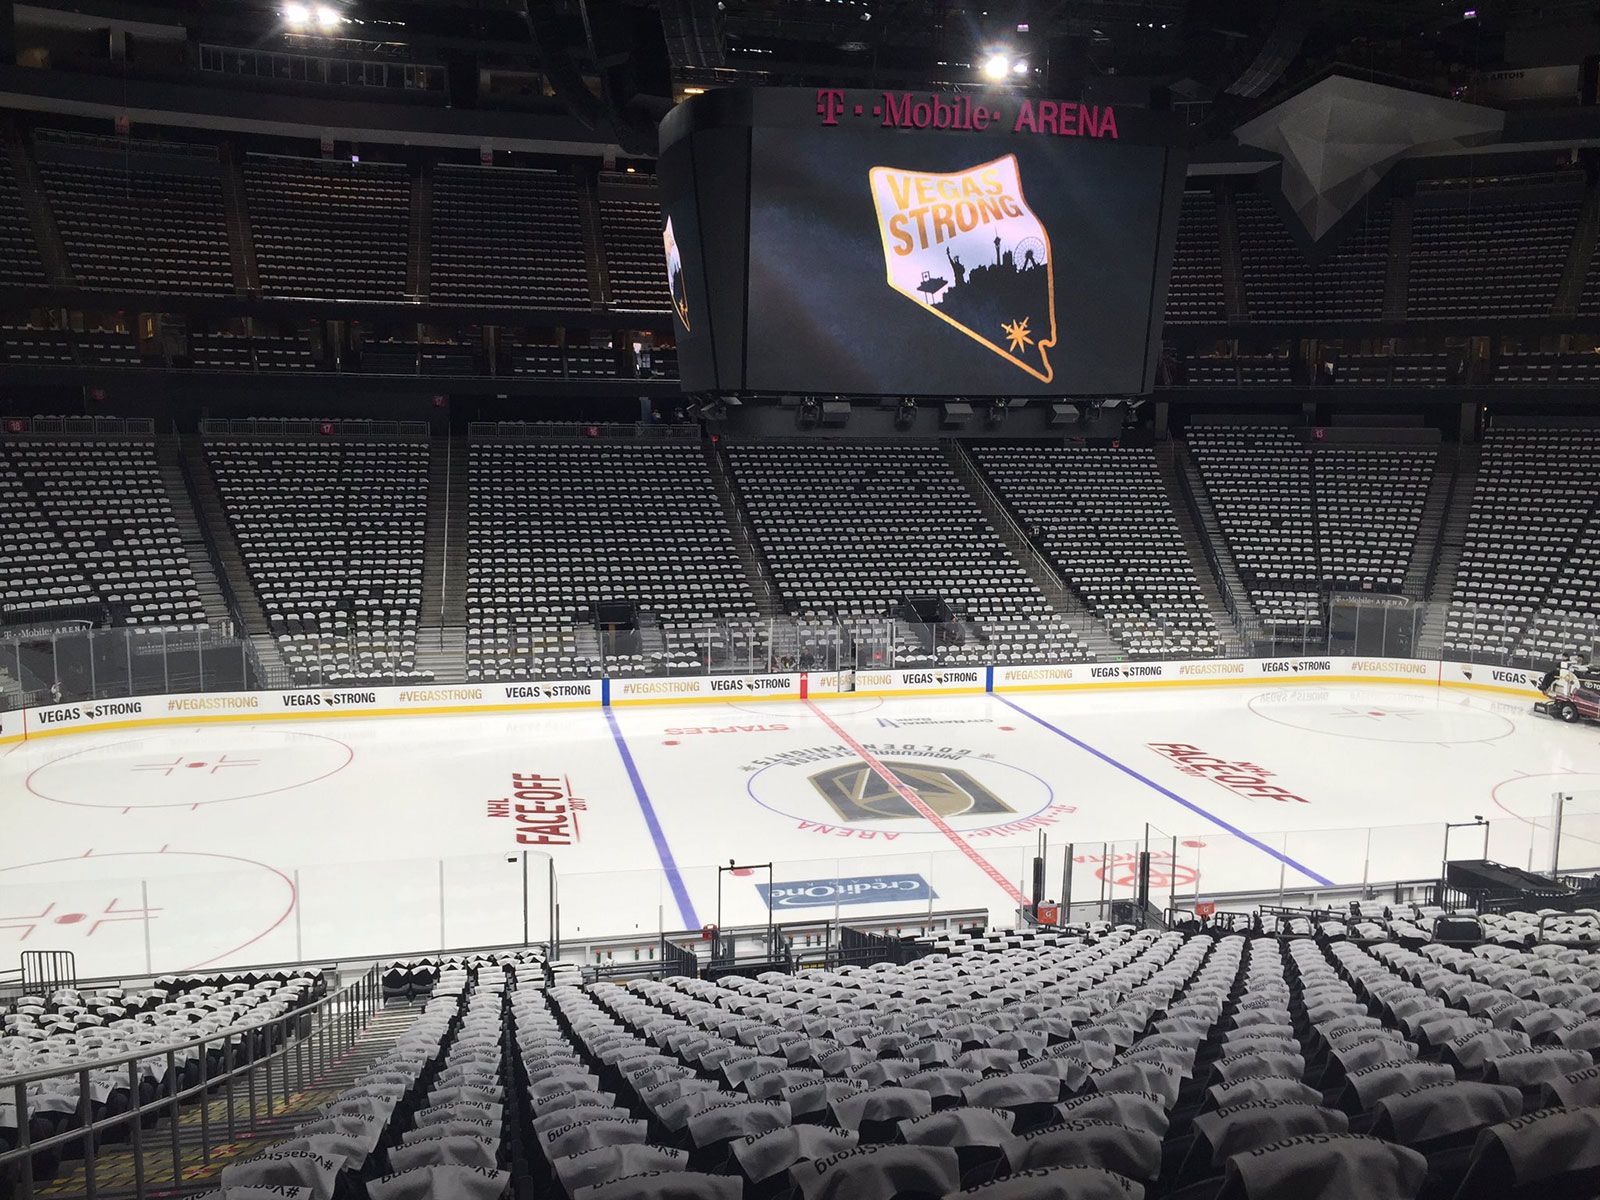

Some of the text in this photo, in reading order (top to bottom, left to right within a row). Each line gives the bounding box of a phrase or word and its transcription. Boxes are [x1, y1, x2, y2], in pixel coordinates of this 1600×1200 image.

[1013, 102, 1119, 140] ARENA
[885, 168, 1004, 210] VEGAS
[888, 194, 1025, 256] STRONG
[55, 624, 87, 634] ARENA
[1090, 664, 1162, 679] VEGAS STRONG
[1179, 661, 1244, 676] #VEGASSTRONG
[1261, 660, 1331, 673] VEGAS STRONG
[1351, 661, 1426, 675] #VEGASSTRONG
[902, 670, 978, 685] VEGAS STRONG
[1004, 667, 1073, 682] #VEGASSTRONG
[1491, 669, 1527, 685] VEGAS
[505, 684, 591, 699] VEGAS STRONG
[623, 680, 701, 695] #VEGASSTRONG
[710, 677, 791, 692] VEGAS STRONG
[282, 691, 376, 707] VEGAS STRONG
[399, 687, 483, 702] #VEGASSTRONG
[167, 695, 259, 712] #VEGASSTRONG
[39, 701, 142, 724] VEGAS STRONG
[664, 724, 789, 735] STAPLES
[862, 743, 972, 756] GOLDEN
[1147, 742, 1311, 803] FACE-OFF
[487, 798, 509, 818] NHL
[512, 772, 571, 845] FACE-OFF
[797, 821, 900, 841] ARENA
